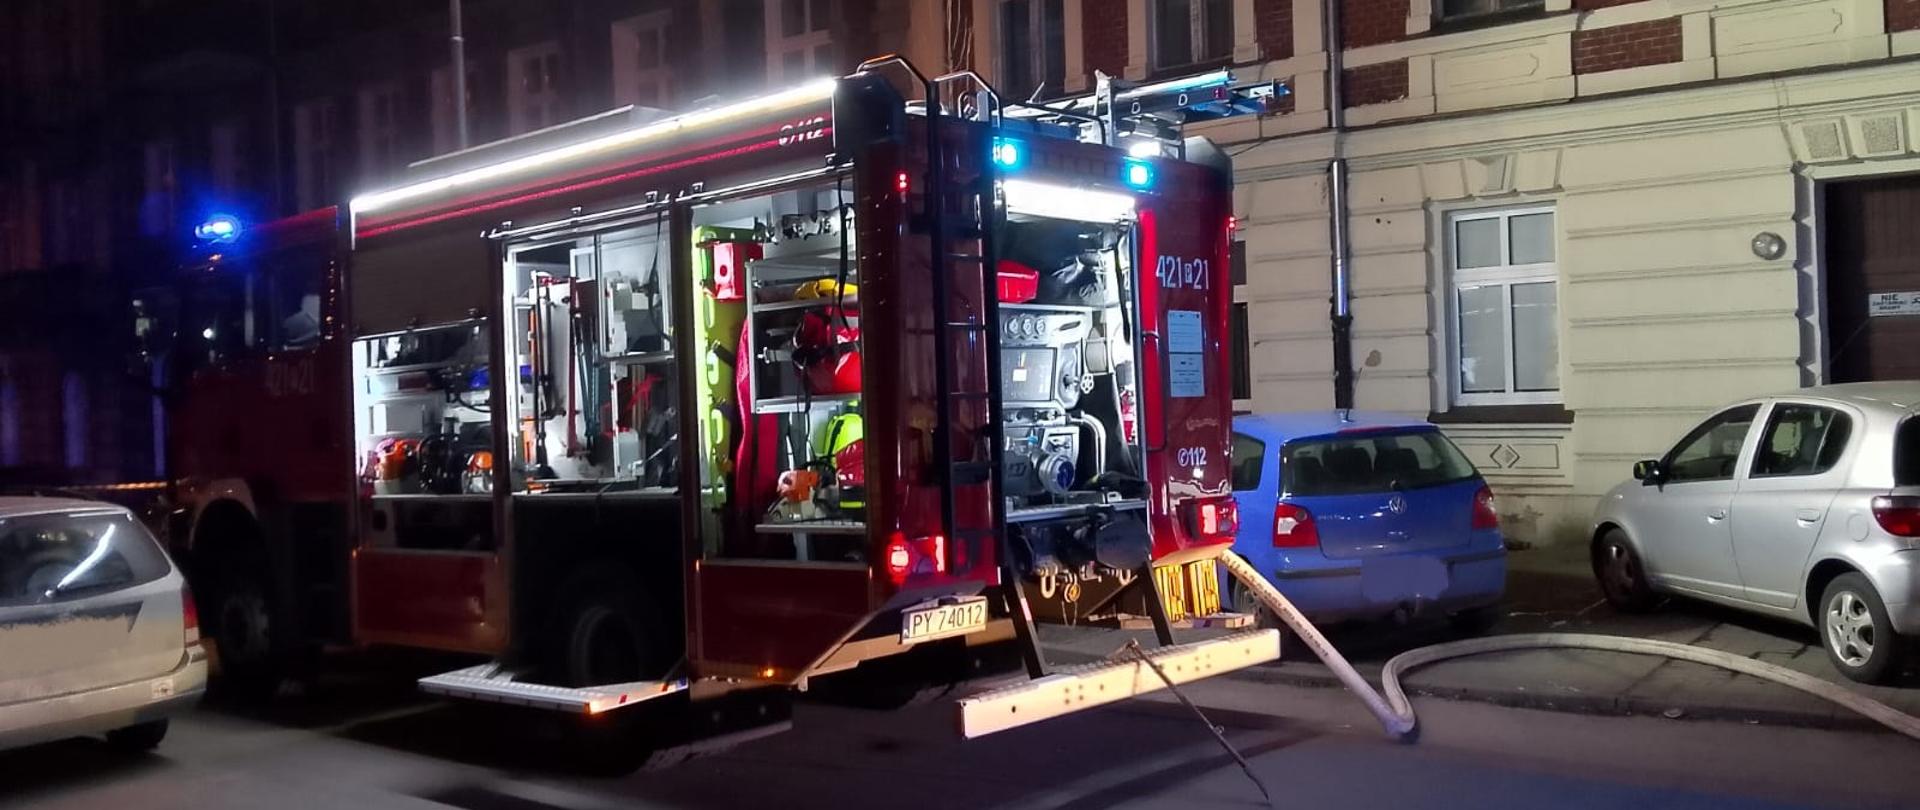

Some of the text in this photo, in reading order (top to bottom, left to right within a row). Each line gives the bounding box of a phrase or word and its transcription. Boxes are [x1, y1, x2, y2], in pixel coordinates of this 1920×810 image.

[798, 117, 824, 141] 112
[1189, 447, 1207, 466] 112
[912, 604, 983, 635] PY 74012
